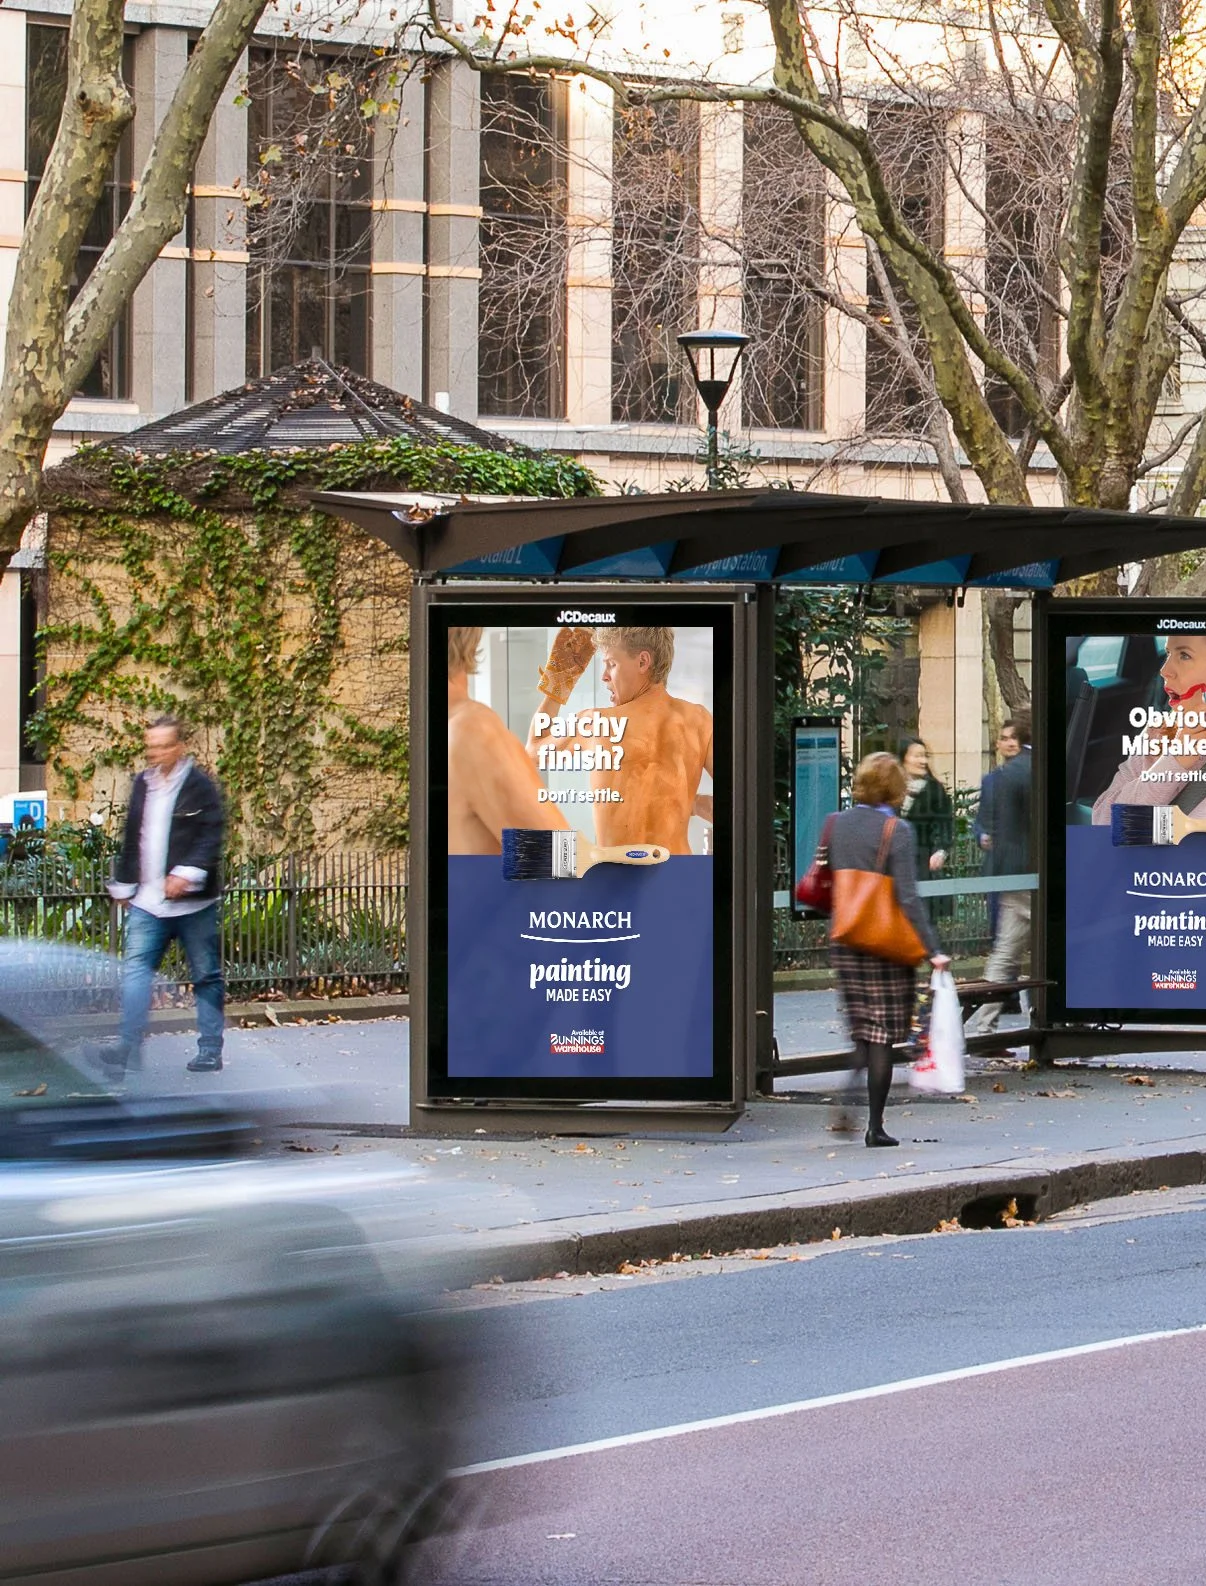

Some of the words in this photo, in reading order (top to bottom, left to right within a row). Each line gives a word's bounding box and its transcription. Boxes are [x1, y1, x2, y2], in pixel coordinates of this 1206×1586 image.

[557, 611, 615, 623] JCDecaux
[1157, 620, 1206, 628] JCDecaux
[534, 712, 629, 744] Patchy
[536, 744, 625, 772] finish?
[1141, 769, 1173, 783] Don't
[537, 789, 577, 803] Don't
[578, 788, 625, 803] settle.
[530, 911, 631, 928] MONARCH
[1148, 936, 1175, 946] MADE
[1179, 936, 1203, 946] EASY
[530, 958, 630, 989] painting
[1151, 972, 1197, 983] BUNNINGS
[1154, 980, 1195, 989] warehouse
[547, 989, 579, 1001] MADE
[583, 989, 612, 1001] EASY
[550, 1033, 605, 1045] BUNNINGS
[553, 1042, 602, 1053] warehouse
